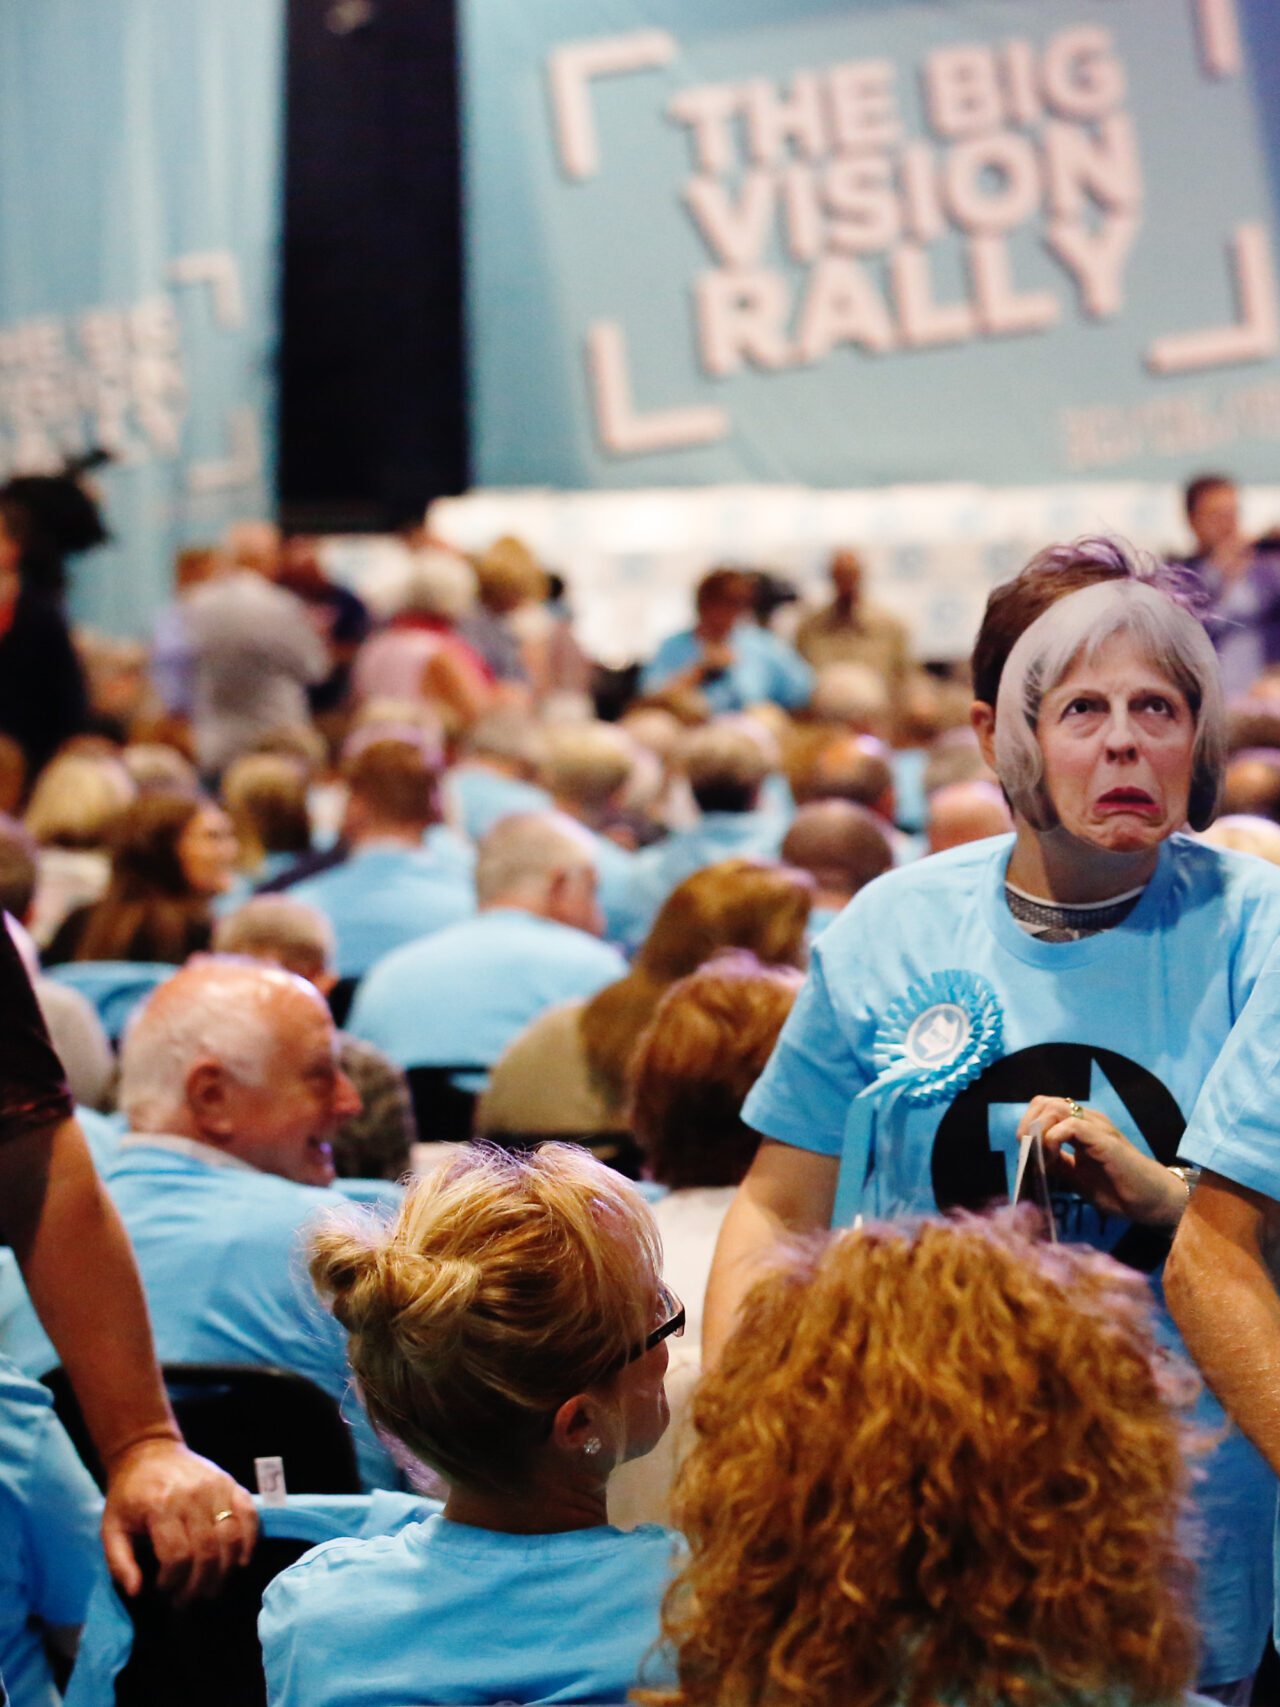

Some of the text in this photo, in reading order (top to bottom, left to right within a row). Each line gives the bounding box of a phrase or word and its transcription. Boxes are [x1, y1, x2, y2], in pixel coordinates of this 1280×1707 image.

[667, 24, 1128, 175] THE BIG
[686, 113, 1145, 267] VISION
[693, 210, 1141, 377] RALLY
